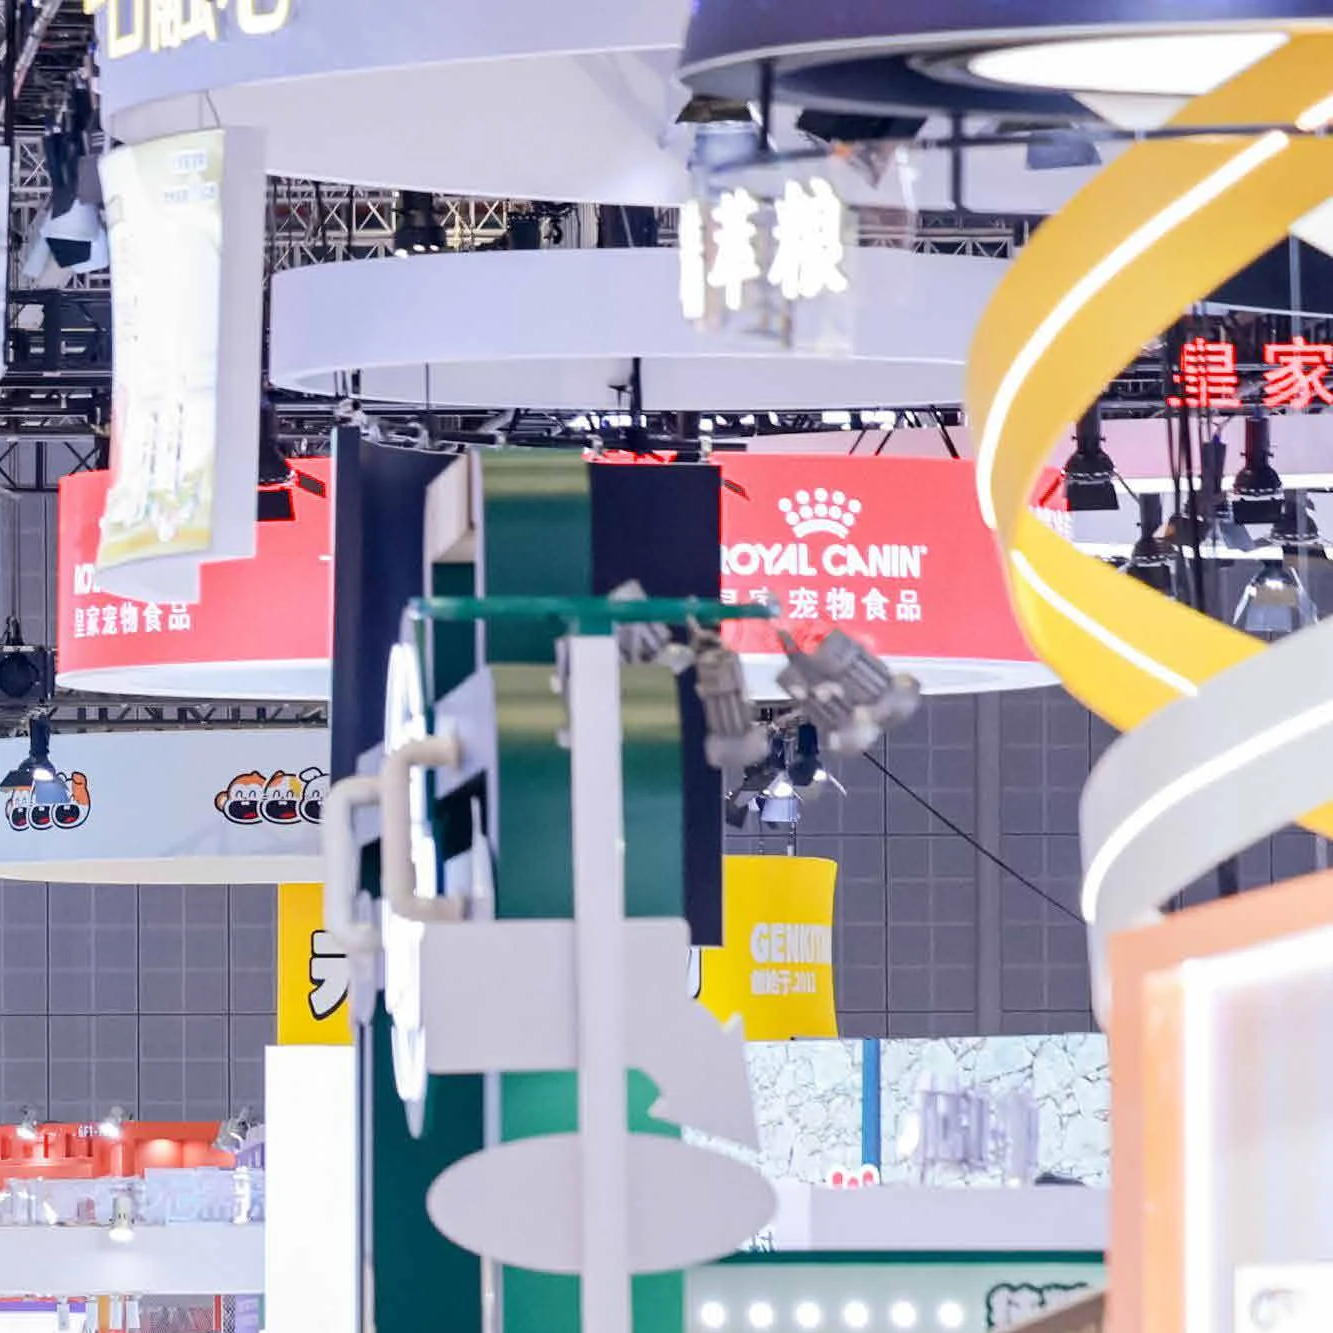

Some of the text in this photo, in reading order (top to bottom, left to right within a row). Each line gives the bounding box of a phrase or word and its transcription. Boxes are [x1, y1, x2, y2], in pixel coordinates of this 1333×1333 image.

[1167, 336, 1333, 410] 皇家
[822, 544, 922, 579] CANIN
[74, 601, 192, 638] 皇家宠物食品
